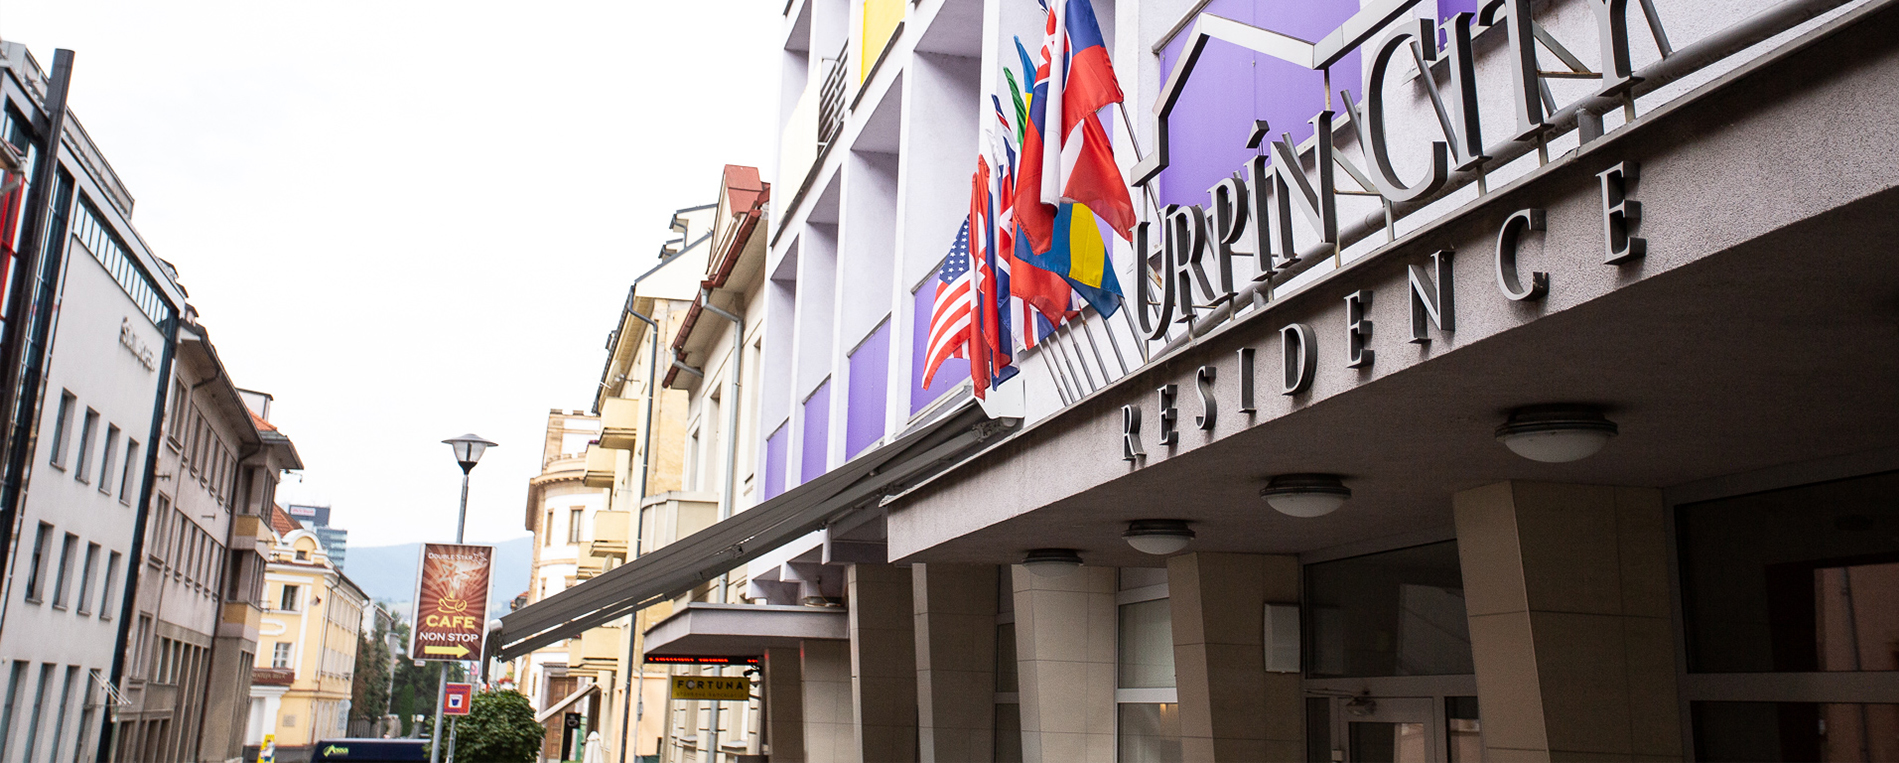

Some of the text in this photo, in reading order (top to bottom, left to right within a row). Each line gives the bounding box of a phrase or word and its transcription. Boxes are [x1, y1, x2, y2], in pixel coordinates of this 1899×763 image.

[1130, 110, 1335, 342] URPÍN
[1121, 160, 1647, 461] RESIDENCE
[426, 614, 476, 629] CAFE
[419, 631, 479, 642] NON STOP
[677, 679, 744, 690] FORTUNA
